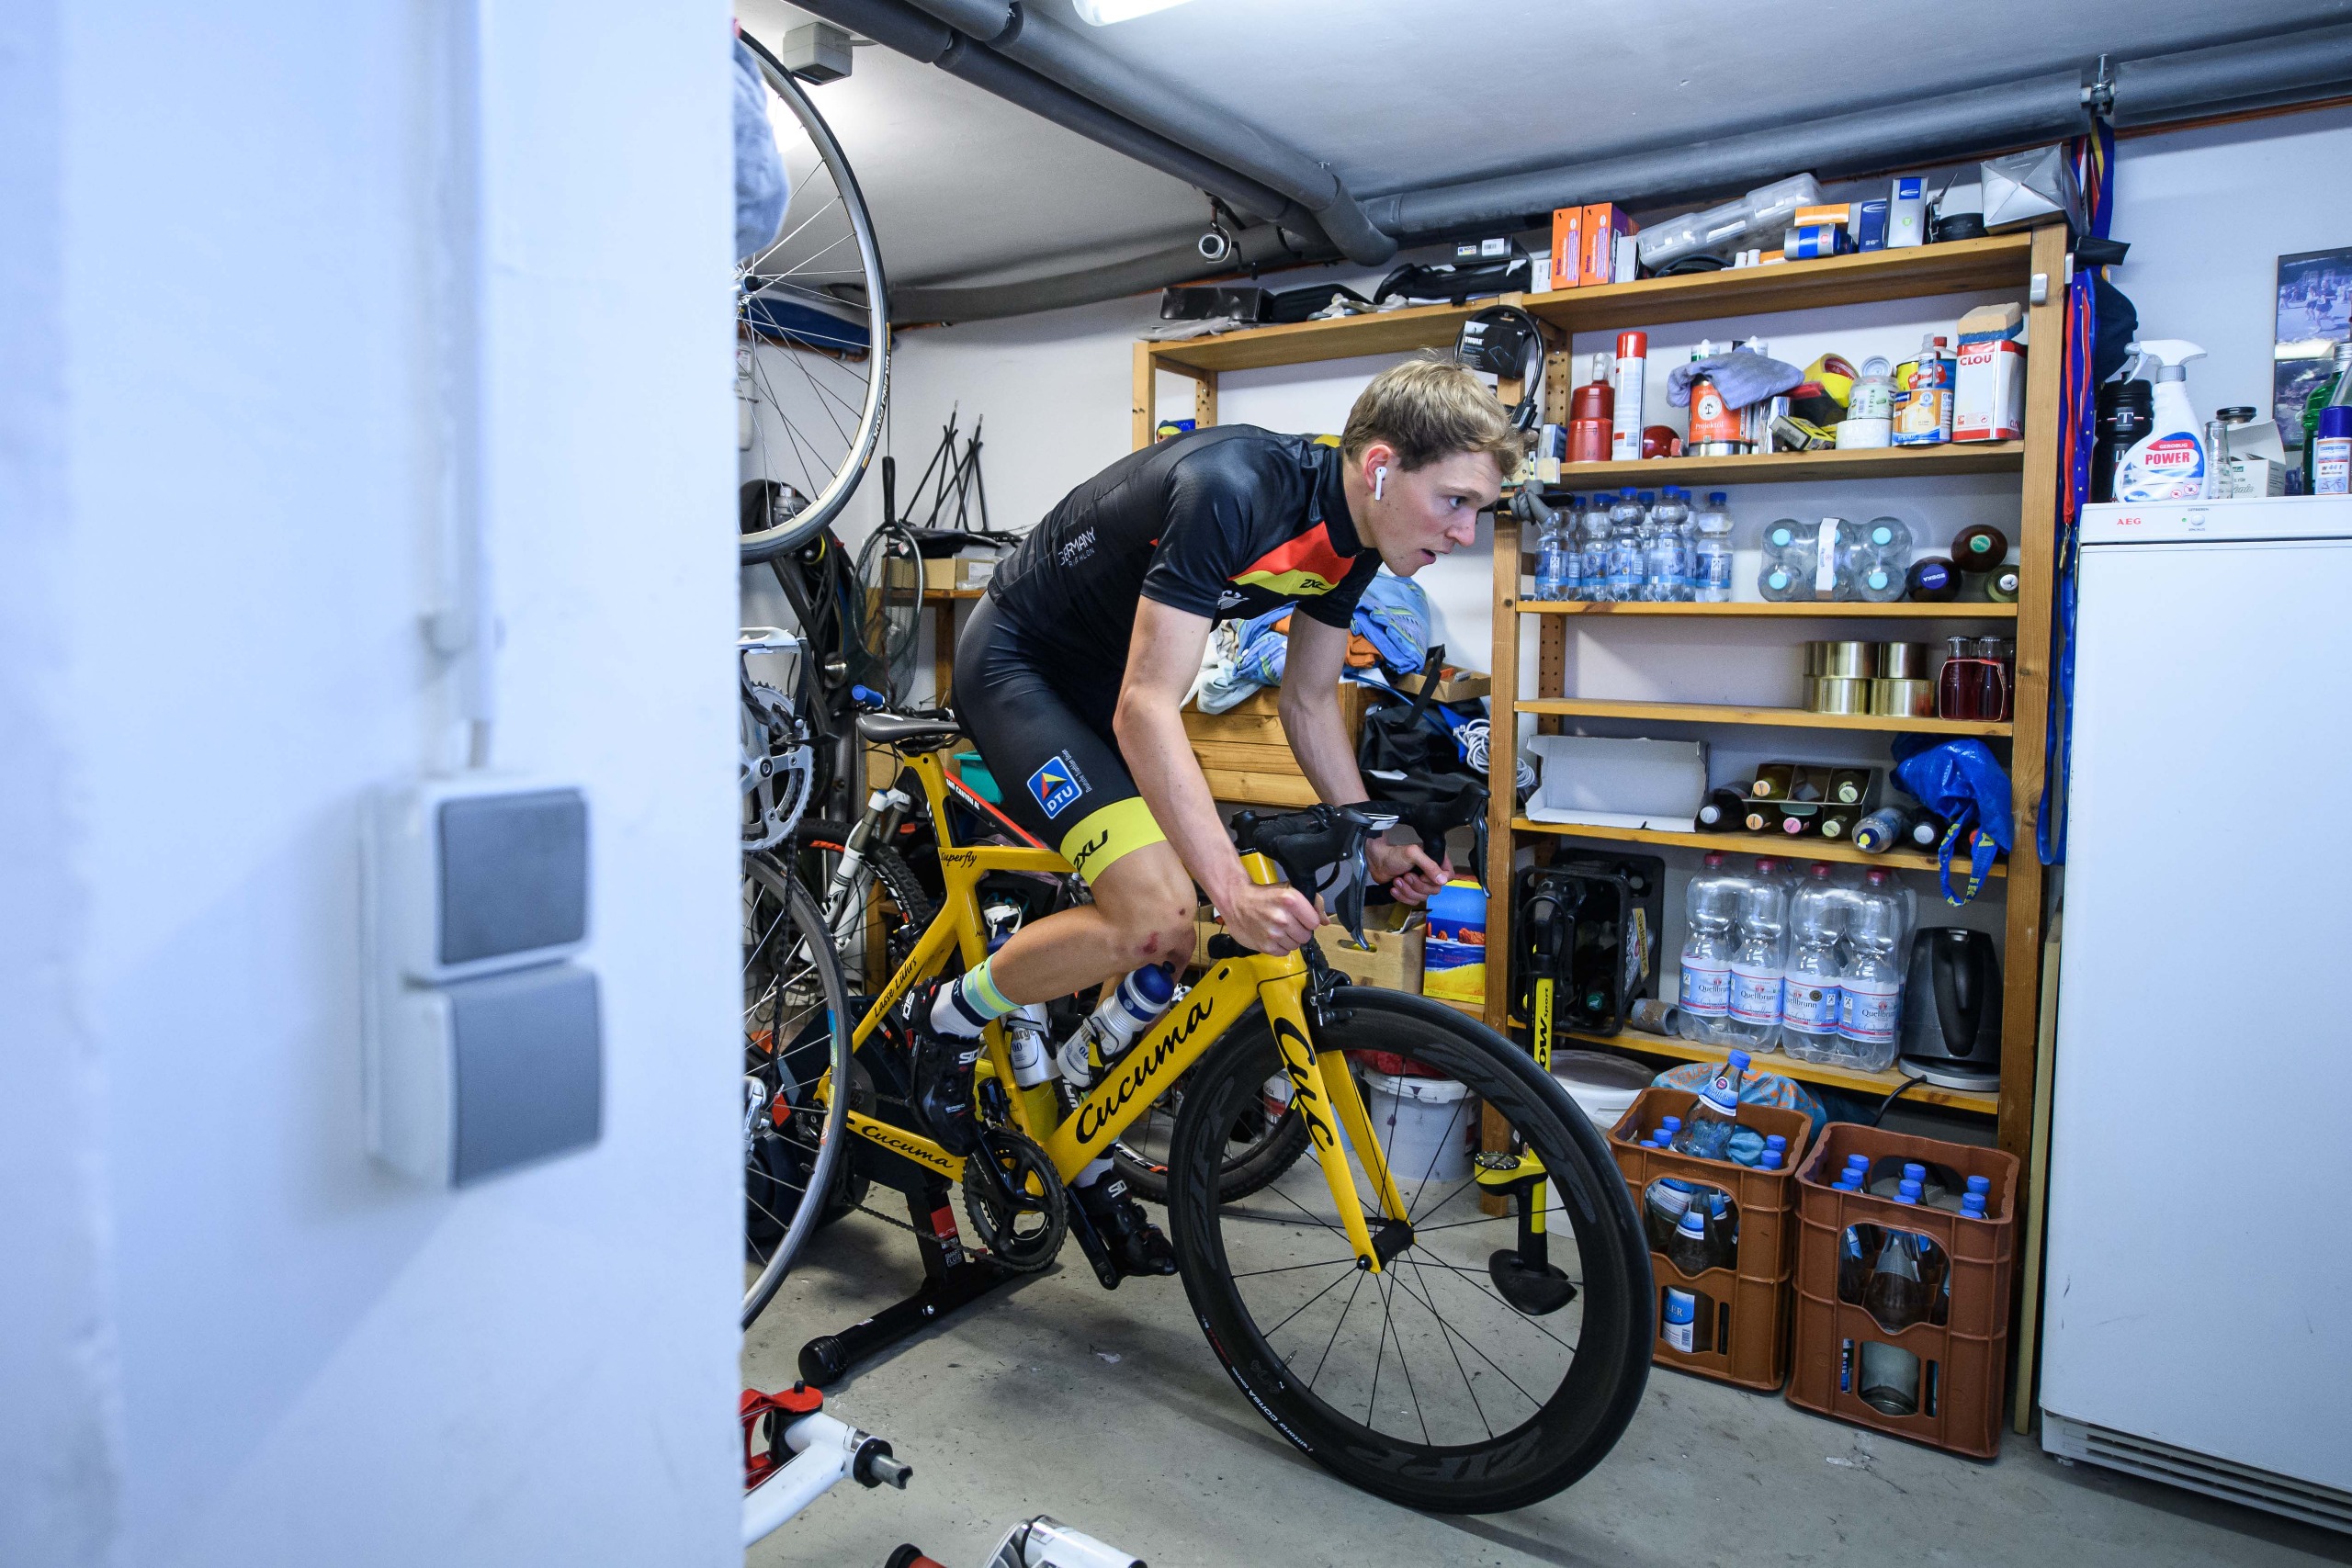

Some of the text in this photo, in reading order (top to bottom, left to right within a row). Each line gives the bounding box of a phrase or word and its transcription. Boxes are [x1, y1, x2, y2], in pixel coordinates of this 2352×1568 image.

[1960, 354, 1992, 367] CLOU
[2145, 451, 2190, 466] POWER
[2117, 517, 2142, 525] AEG
[1057, 525, 1096, 567] GERMANY
[1046, 784, 1073, 812] DTU
[940, 851, 978, 868] Superfly
[1073, 829, 1108, 871] 2XU
[874, 956, 917, 1019] Lasse Lührs
[1698, 984, 1728, 993] Quellbru
[1075, 996, 1214, 1145] Cucuma
[861, 1125, 955, 1168] Cucuma
[1249, 1389, 1279, 1422] CORSA
